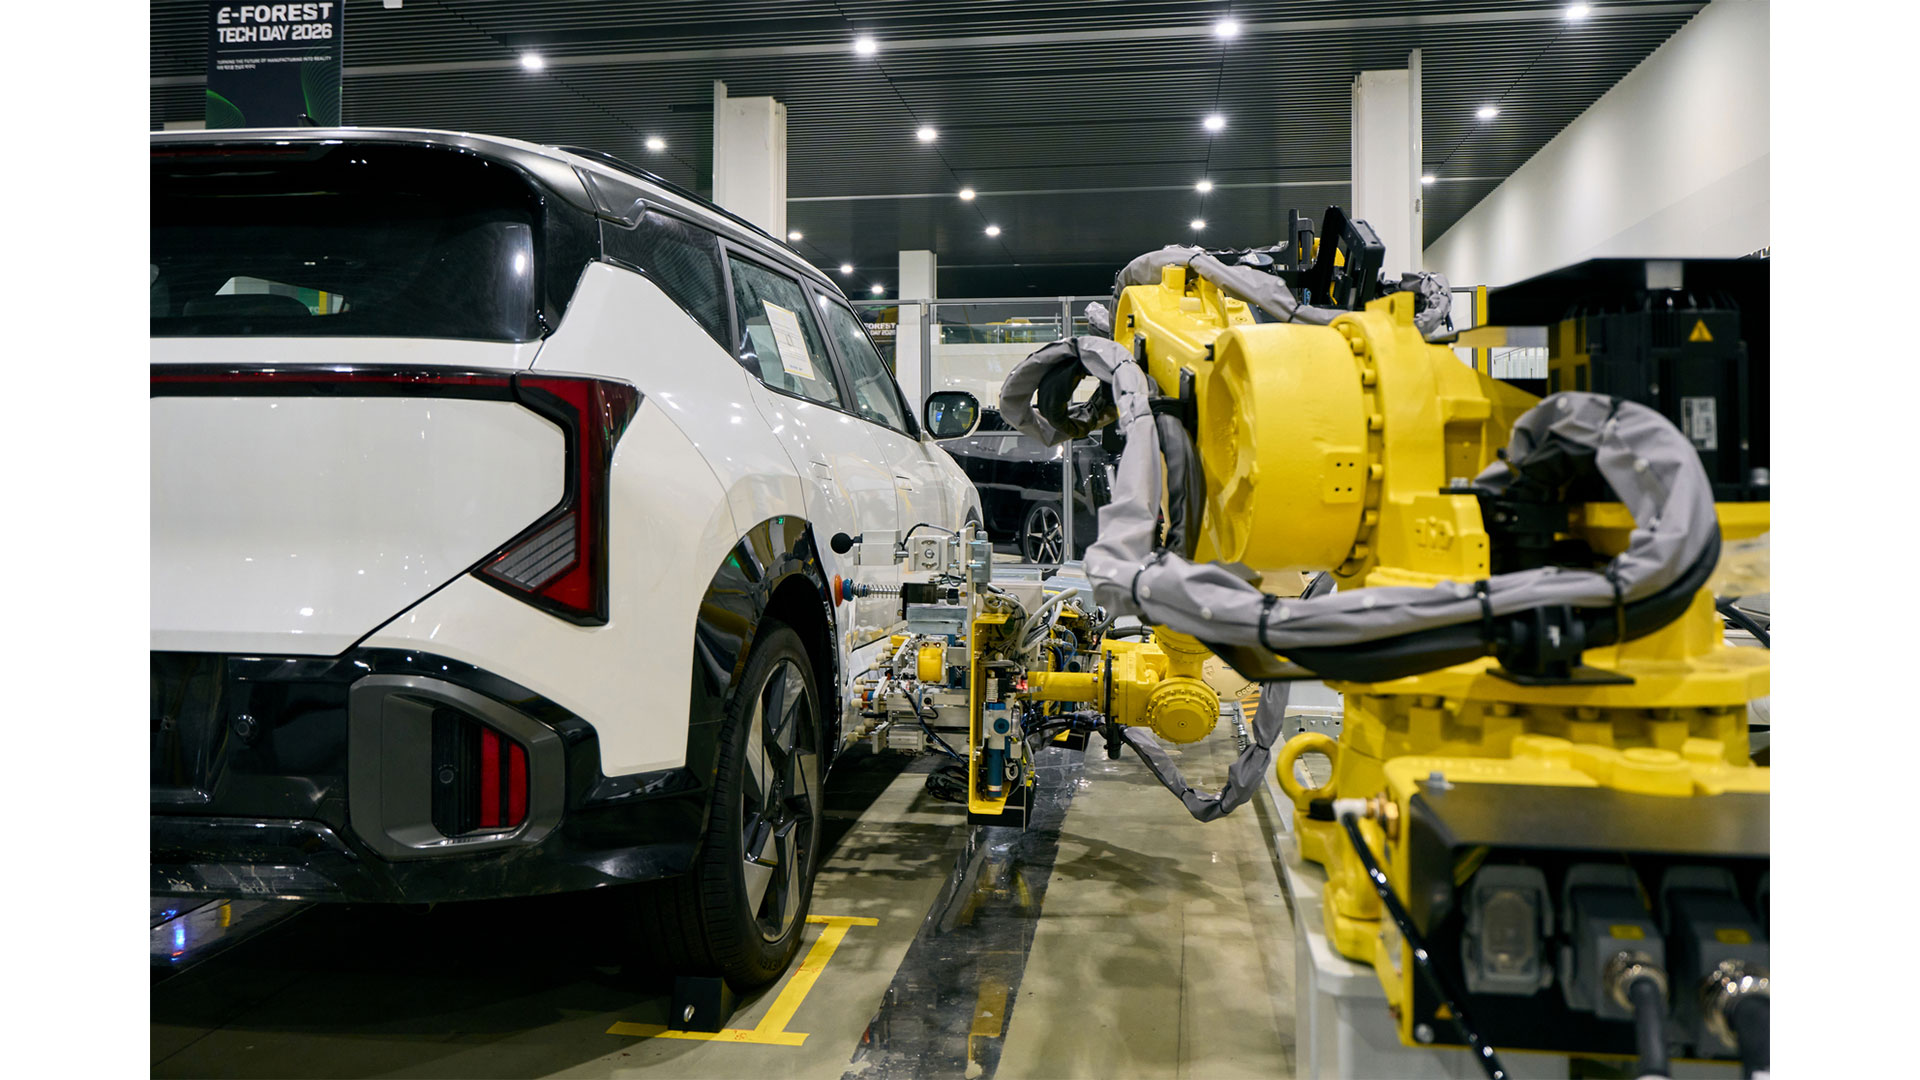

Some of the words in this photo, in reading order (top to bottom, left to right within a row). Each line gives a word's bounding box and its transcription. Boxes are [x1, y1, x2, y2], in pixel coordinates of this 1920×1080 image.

[217, 2, 333, 24] E-FOREST
[217, 26, 257, 43] TECH
[259, 25, 290, 42] DAY
[291, 23, 333, 41] 2026
